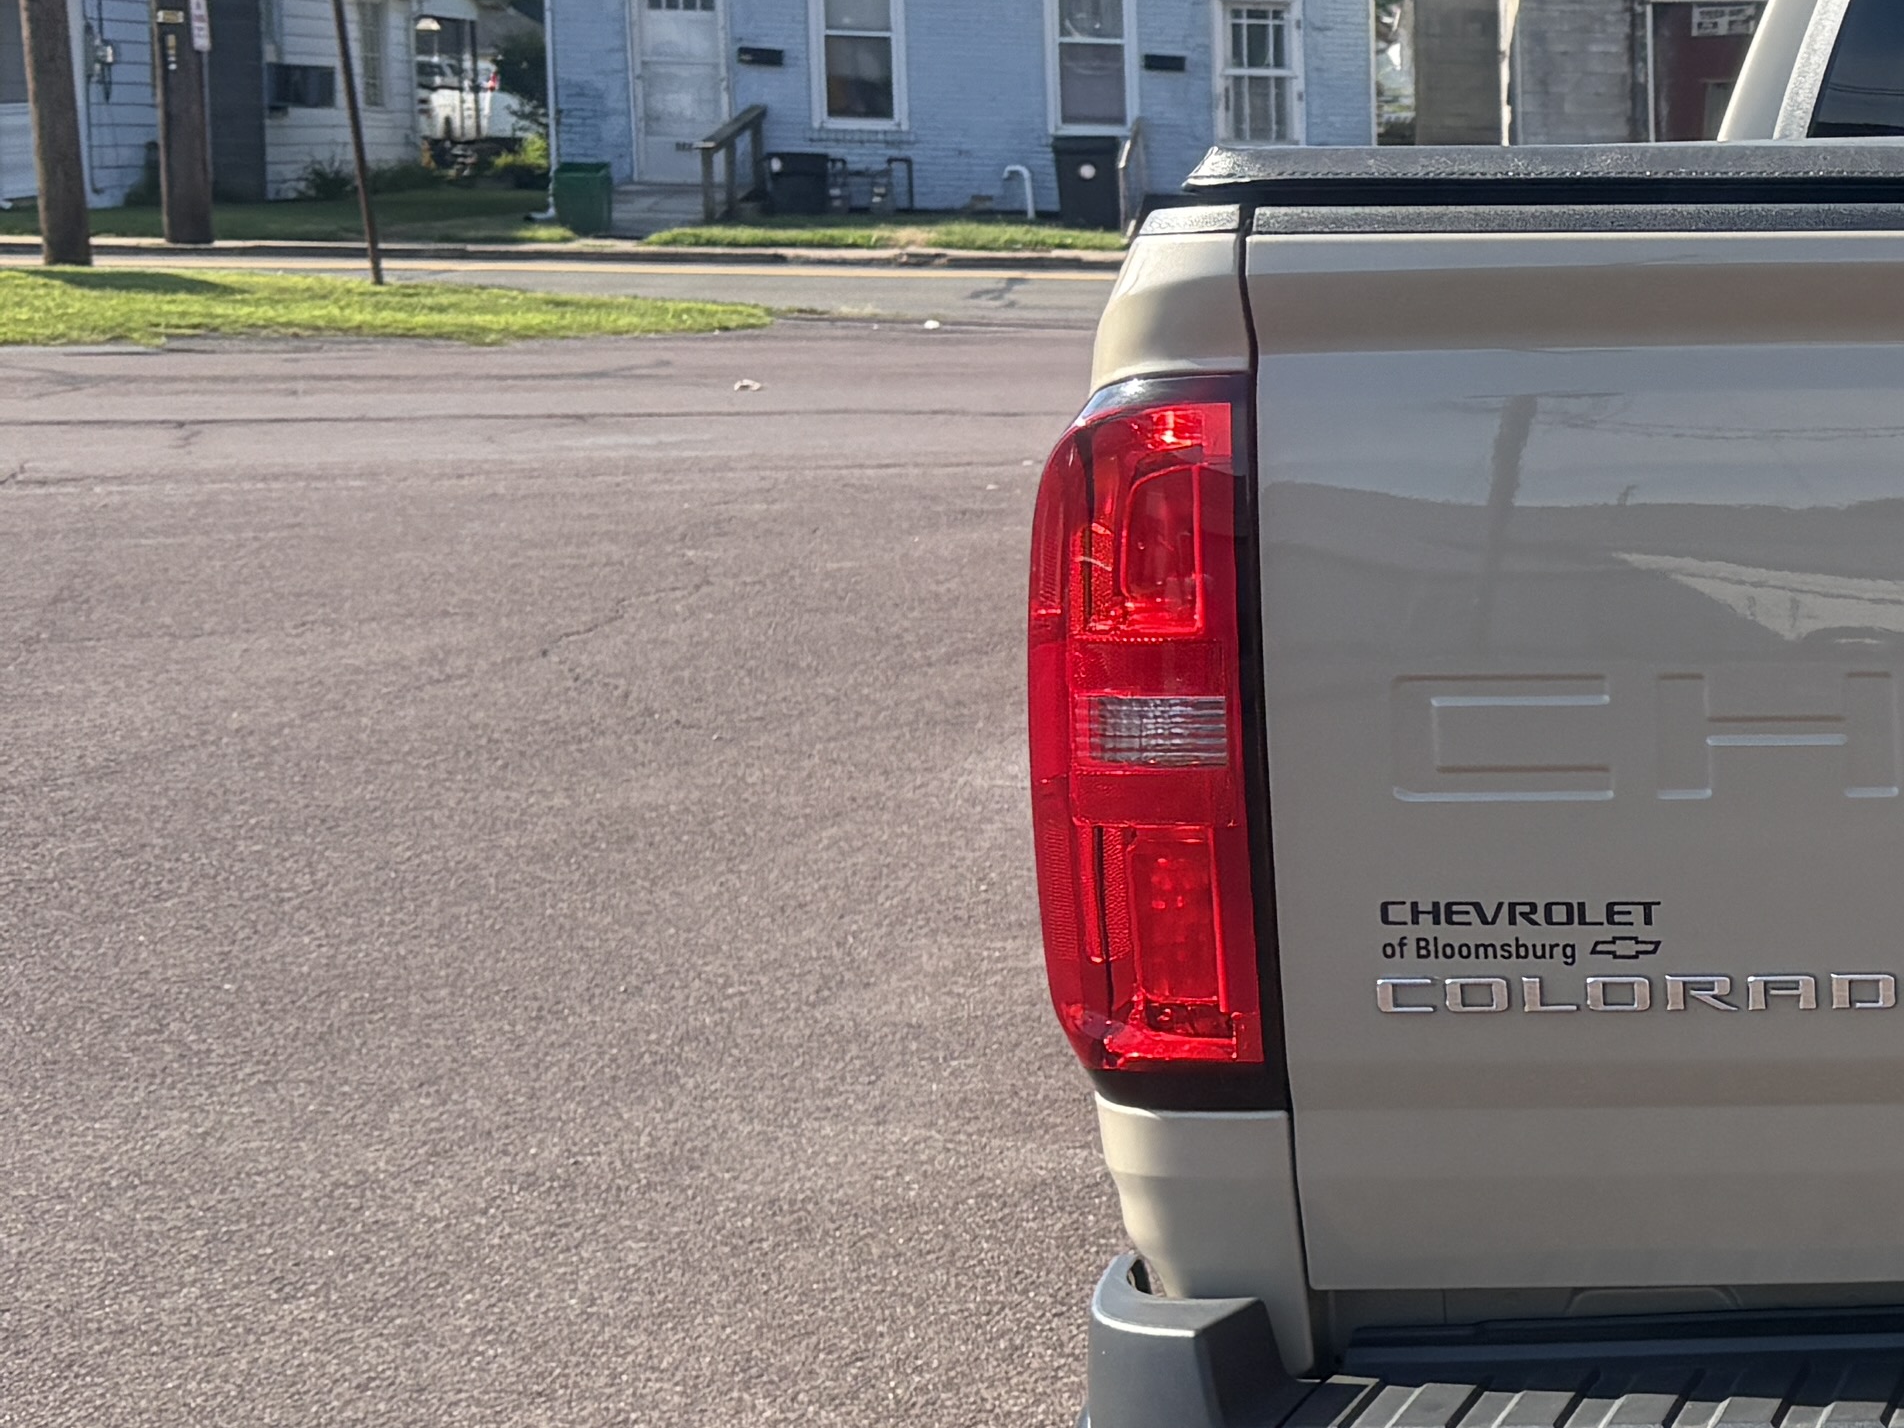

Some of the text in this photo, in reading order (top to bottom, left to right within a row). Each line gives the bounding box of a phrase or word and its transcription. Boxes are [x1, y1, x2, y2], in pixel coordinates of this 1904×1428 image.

[1380, 900, 1662, 927] CHEVROLET
[1381, 935, 1577, 967] of Bloomsburg
